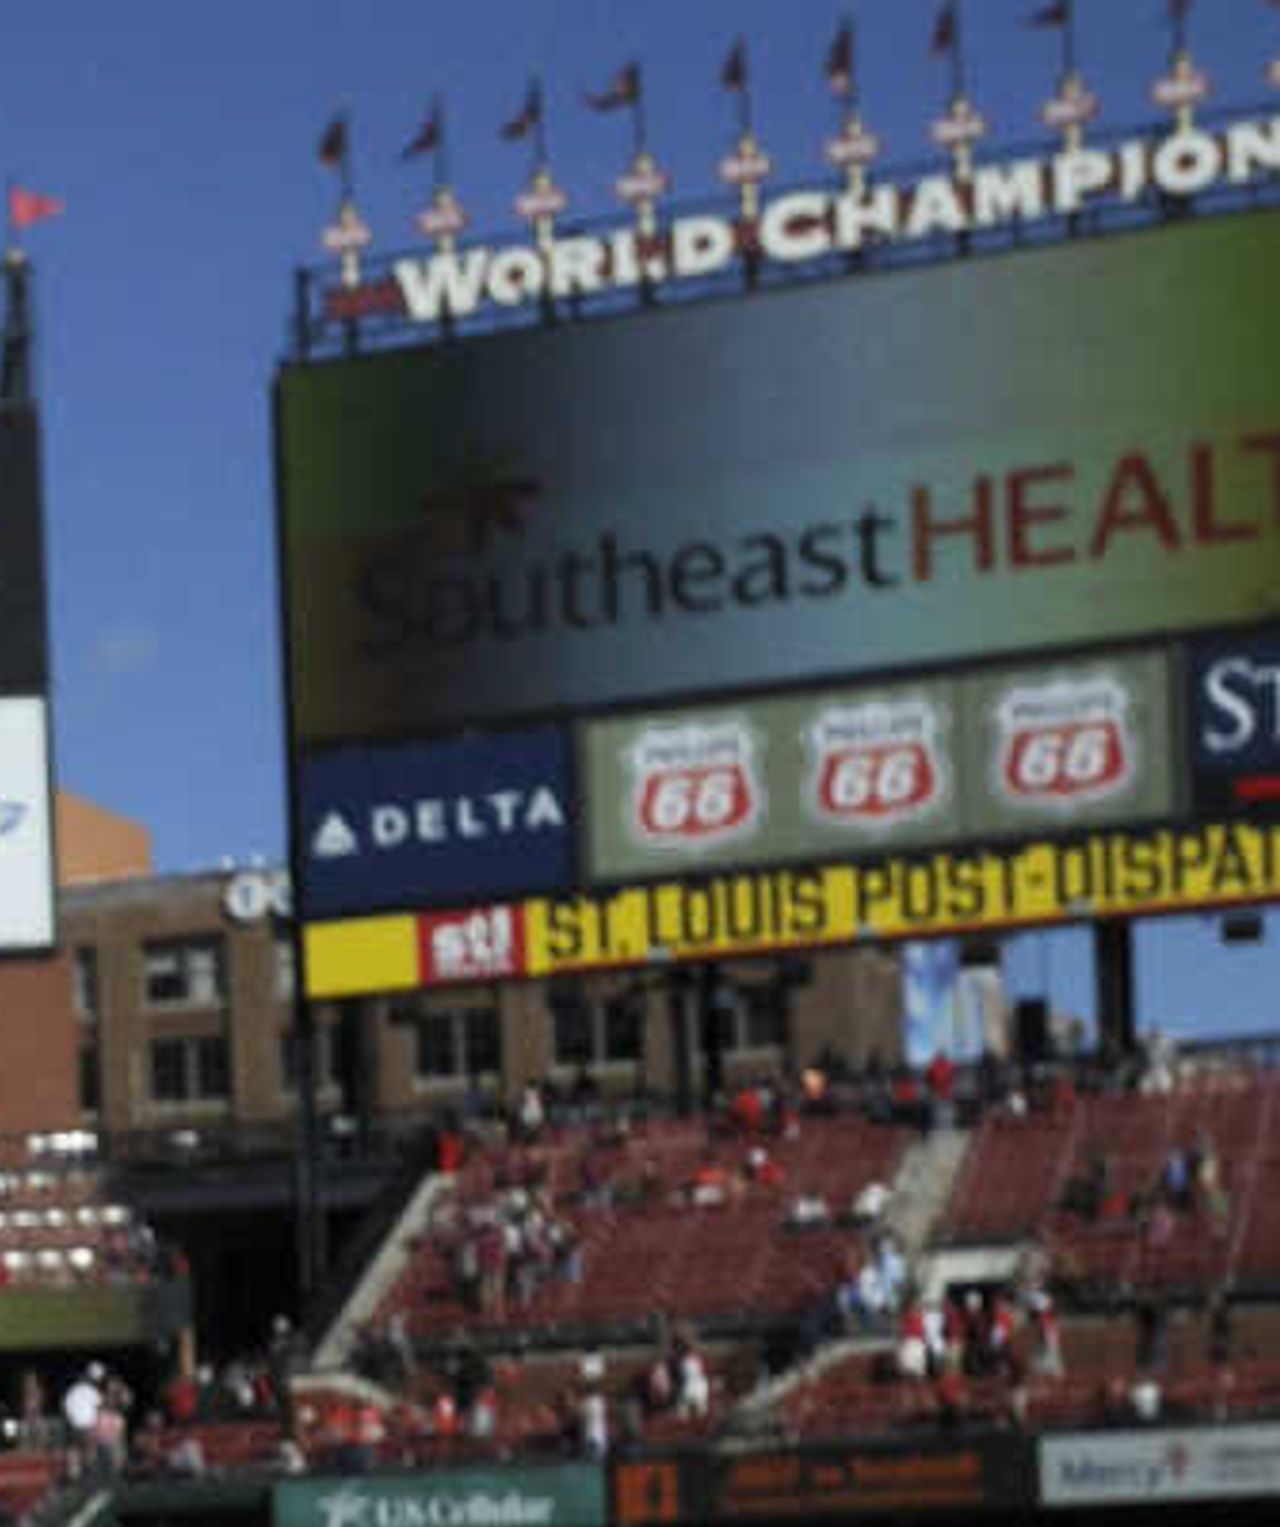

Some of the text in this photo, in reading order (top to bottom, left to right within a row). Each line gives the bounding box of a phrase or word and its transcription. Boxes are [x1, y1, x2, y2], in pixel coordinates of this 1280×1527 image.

[829, 749, 918, 810] 66
[1020, 725, 1110, 788] 66
[372, 786, 565, 849] DELTA
[650, 771, 736, 829] 66
[547, 896, 631, 960] ST.
[646, 873, 828, 950] LOUIS
